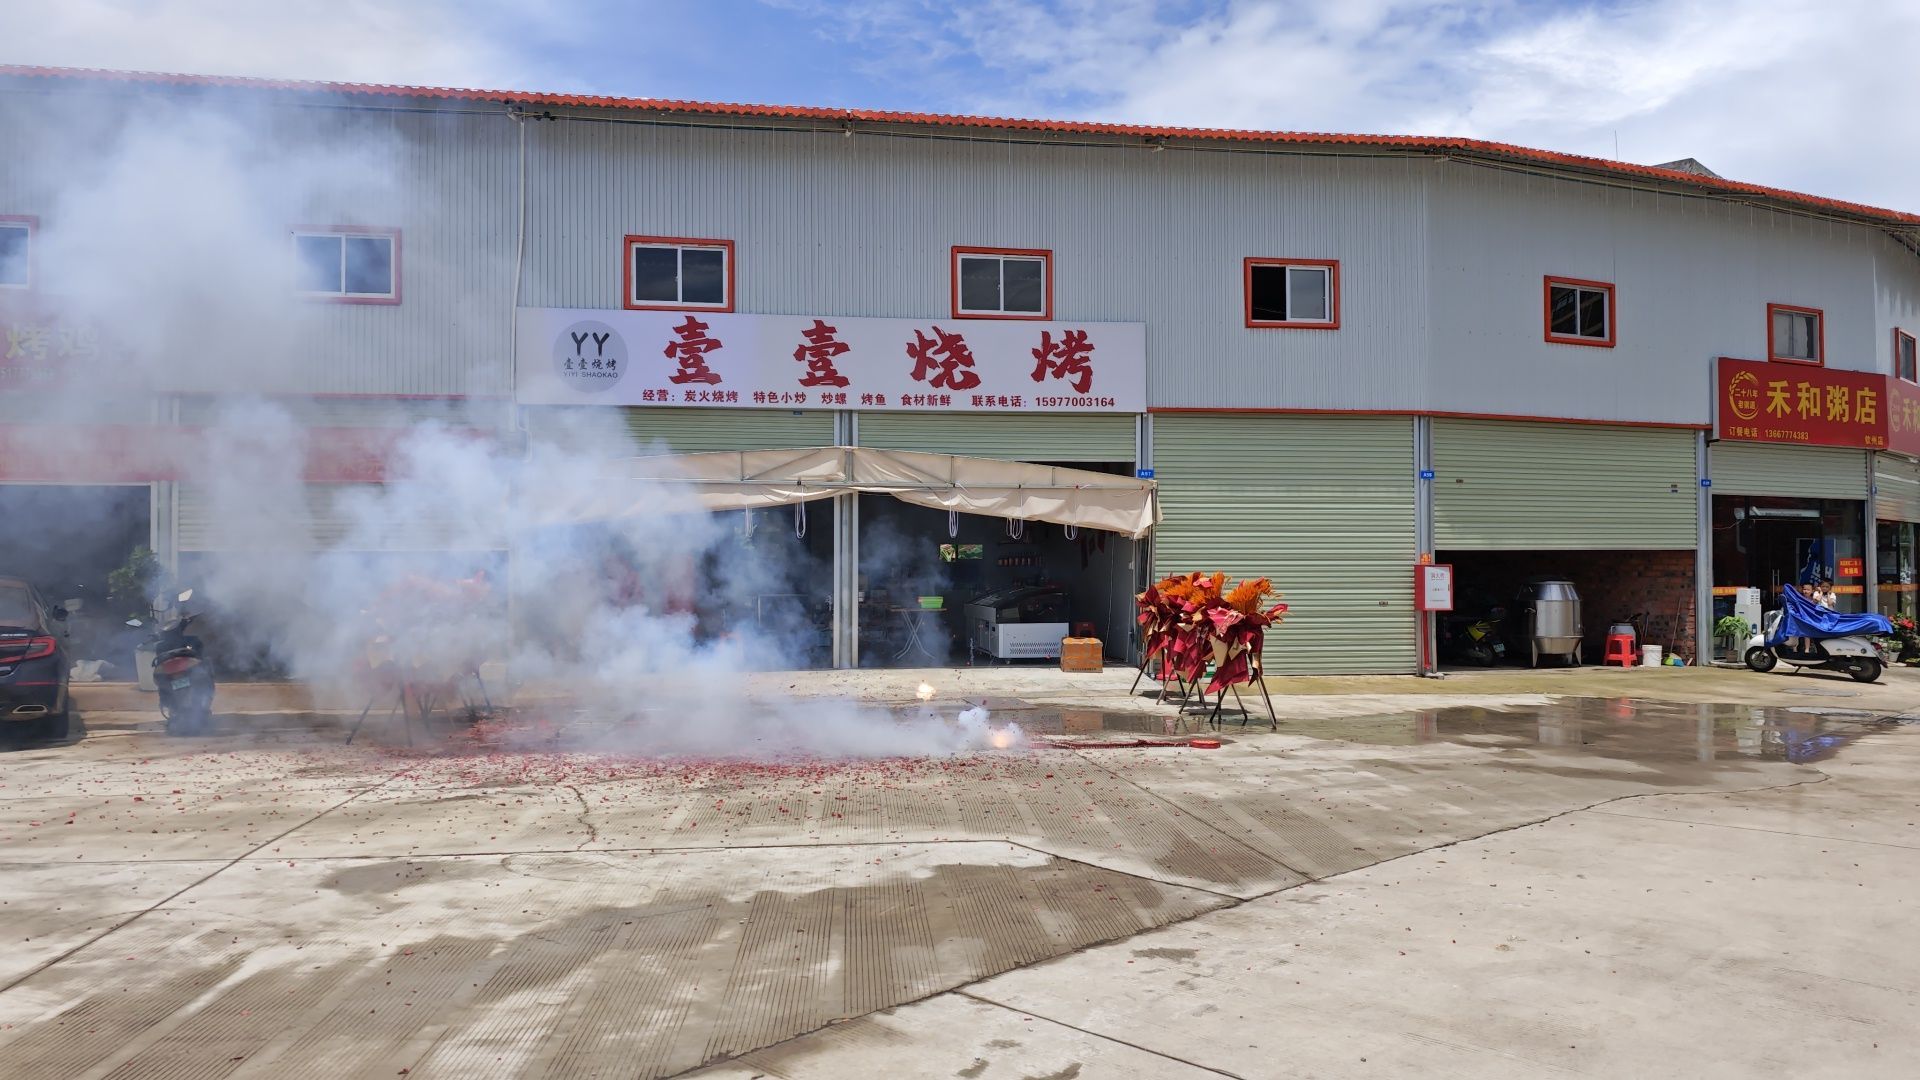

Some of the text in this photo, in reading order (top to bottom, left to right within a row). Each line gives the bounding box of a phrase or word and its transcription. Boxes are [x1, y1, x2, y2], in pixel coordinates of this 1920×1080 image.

[571, 331, 610, 356] YY
[664, 315, 1096, 394] 壹壹烧烤
[564, 357, 617, 371] 壹壹烧烤
[753, 391, 807, 404] 特色小炒
[821, 392, 847, 406] 炒螺
[861, 393, 886, 406] 烤鱼
[901, 394, 951, 406] 食材新鲜
[1735, 388, 1758, 398] 二十八年
[1766, 380, 1877, 425] 禾和粥店
[1729, 426, 1809, 440] 订餐电话 13667774383
